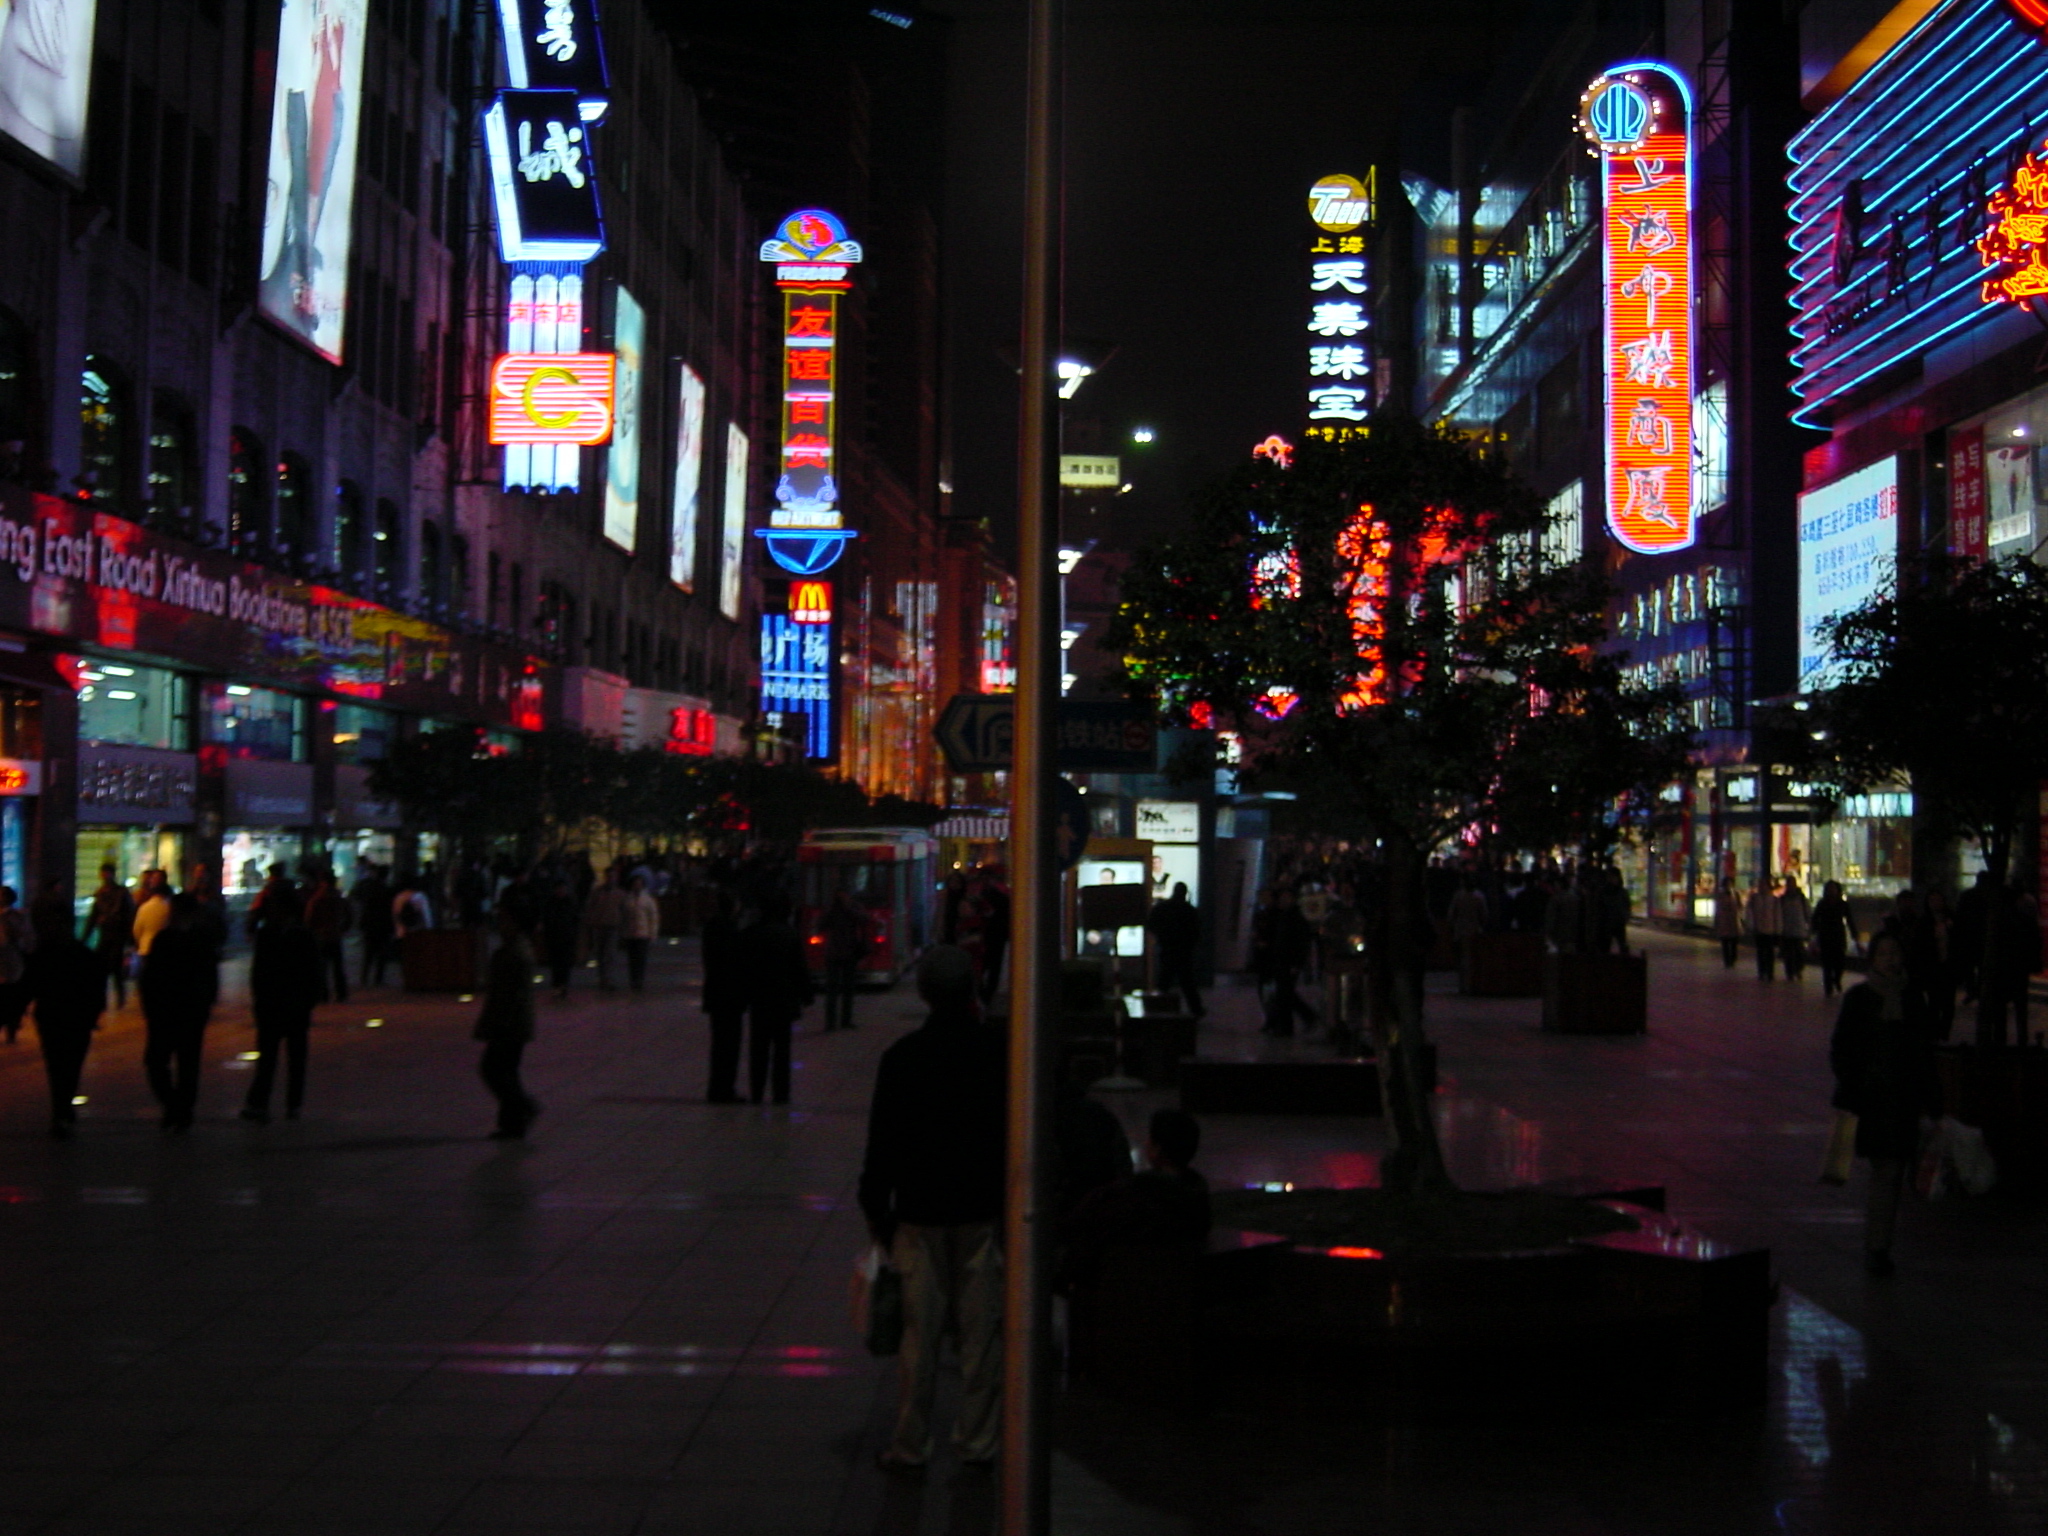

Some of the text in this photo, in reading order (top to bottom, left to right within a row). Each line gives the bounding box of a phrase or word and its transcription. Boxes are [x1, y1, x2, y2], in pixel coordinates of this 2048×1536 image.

[44, 517, 93, 583] East
[99, 534, 157, 597] Road
[161, 552, 226, 616] Xinhua
